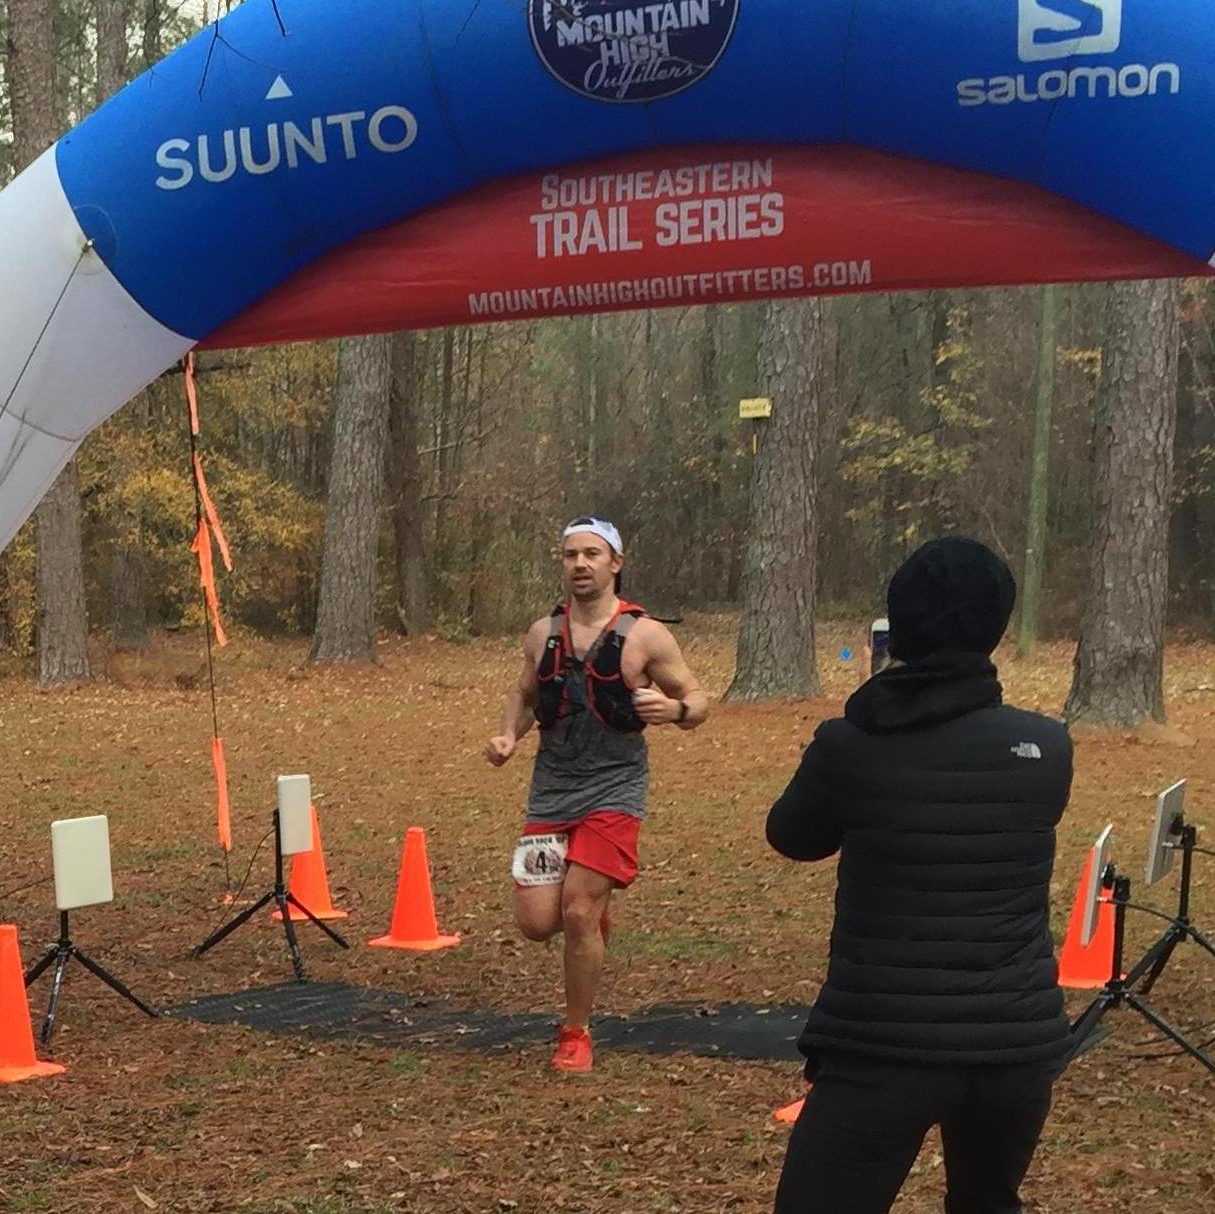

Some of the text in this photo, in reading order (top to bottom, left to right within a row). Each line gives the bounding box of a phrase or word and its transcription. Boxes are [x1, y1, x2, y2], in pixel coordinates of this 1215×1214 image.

[556, 0, 710, 47] MOUNTAIN
[600, 31, 671, 67] HIGH
[584, 55, 707, 99] Outfitters
[155, 105, 418, 190] SUUNTO
[541, 159, 773, 211] SOUTHEASTERN
[530, 192, 784, 258] TRAIL SERIES
[468, 260, 872, 316] MOUNTAINHIGHOUTFITTERS.COM
[535, 850, 547, 874] 4
